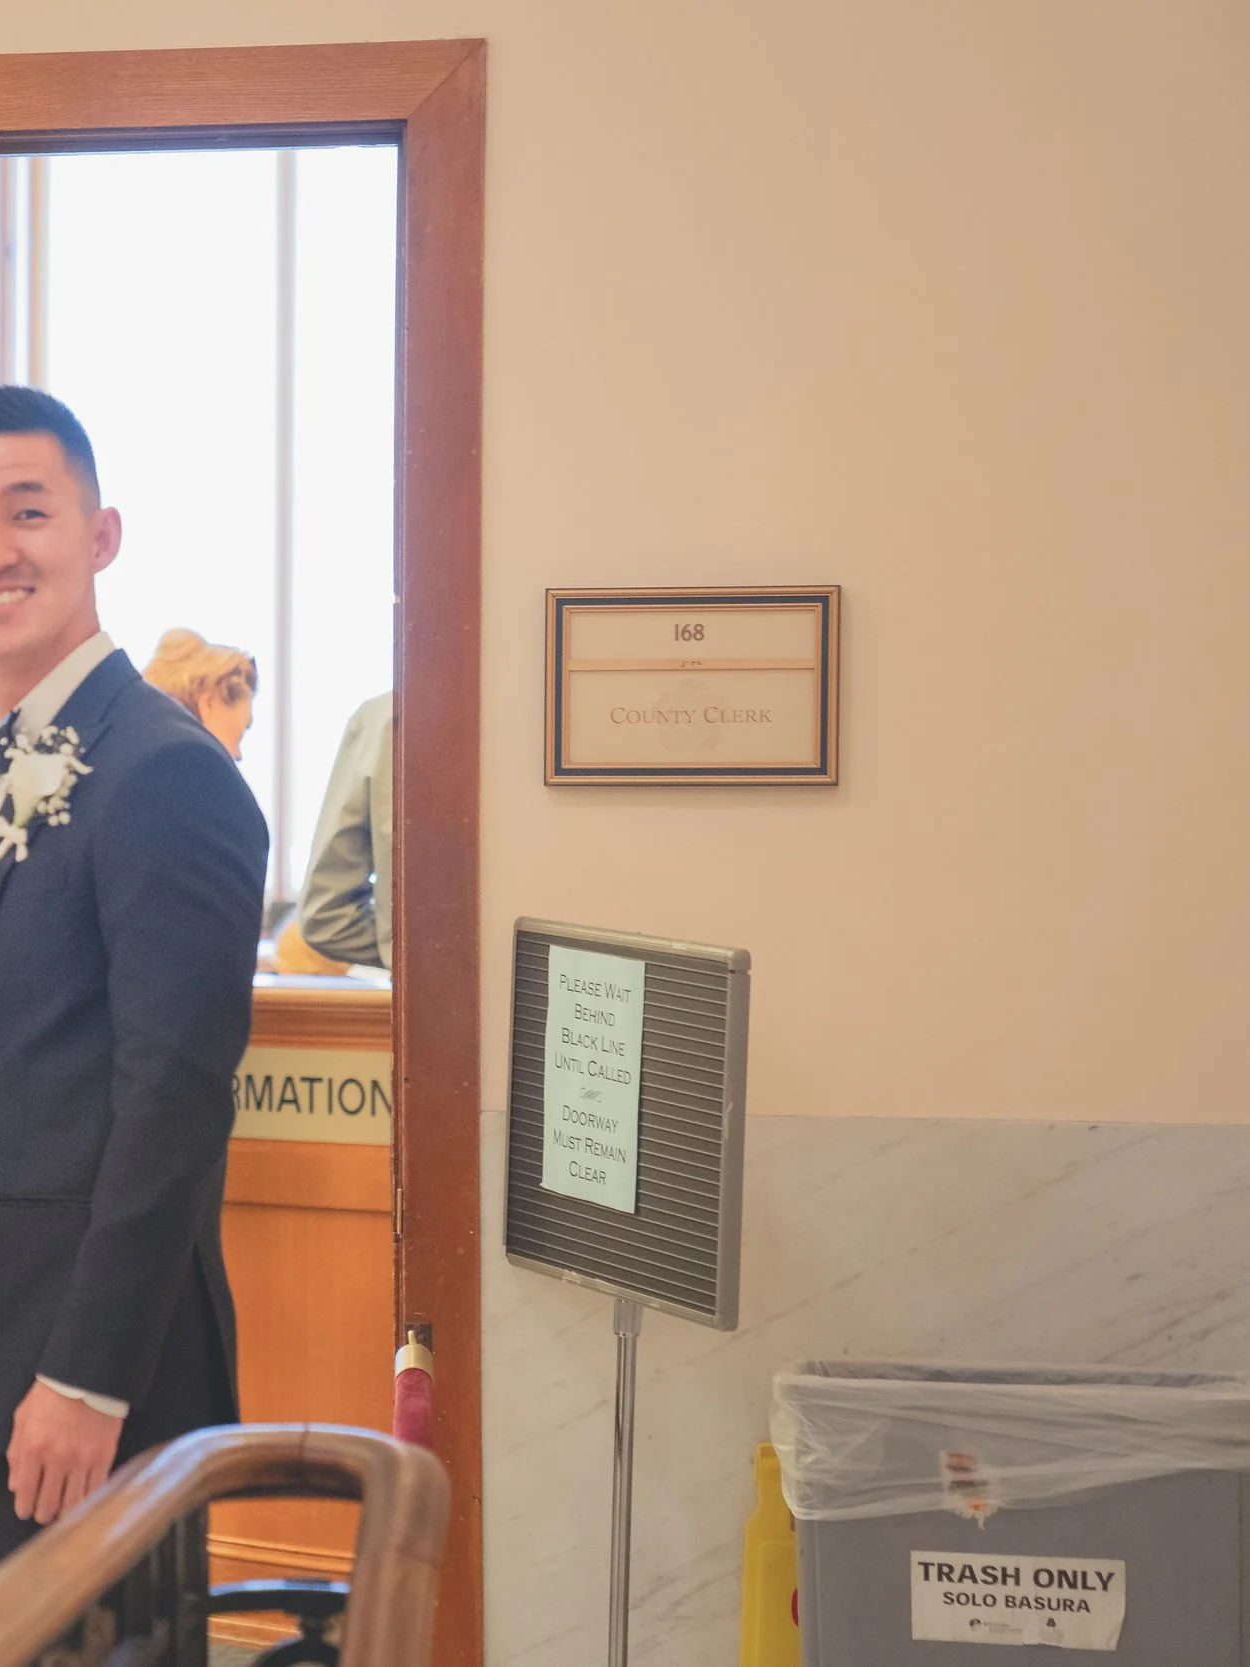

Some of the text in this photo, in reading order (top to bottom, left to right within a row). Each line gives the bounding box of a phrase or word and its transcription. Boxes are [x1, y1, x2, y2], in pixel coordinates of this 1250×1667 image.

[673, 623, 706, 642] 168
[917, 1560, 1115, 1593] TRASH ONLY
[942, 1591, 1091, 1614] SOLO BASURA
